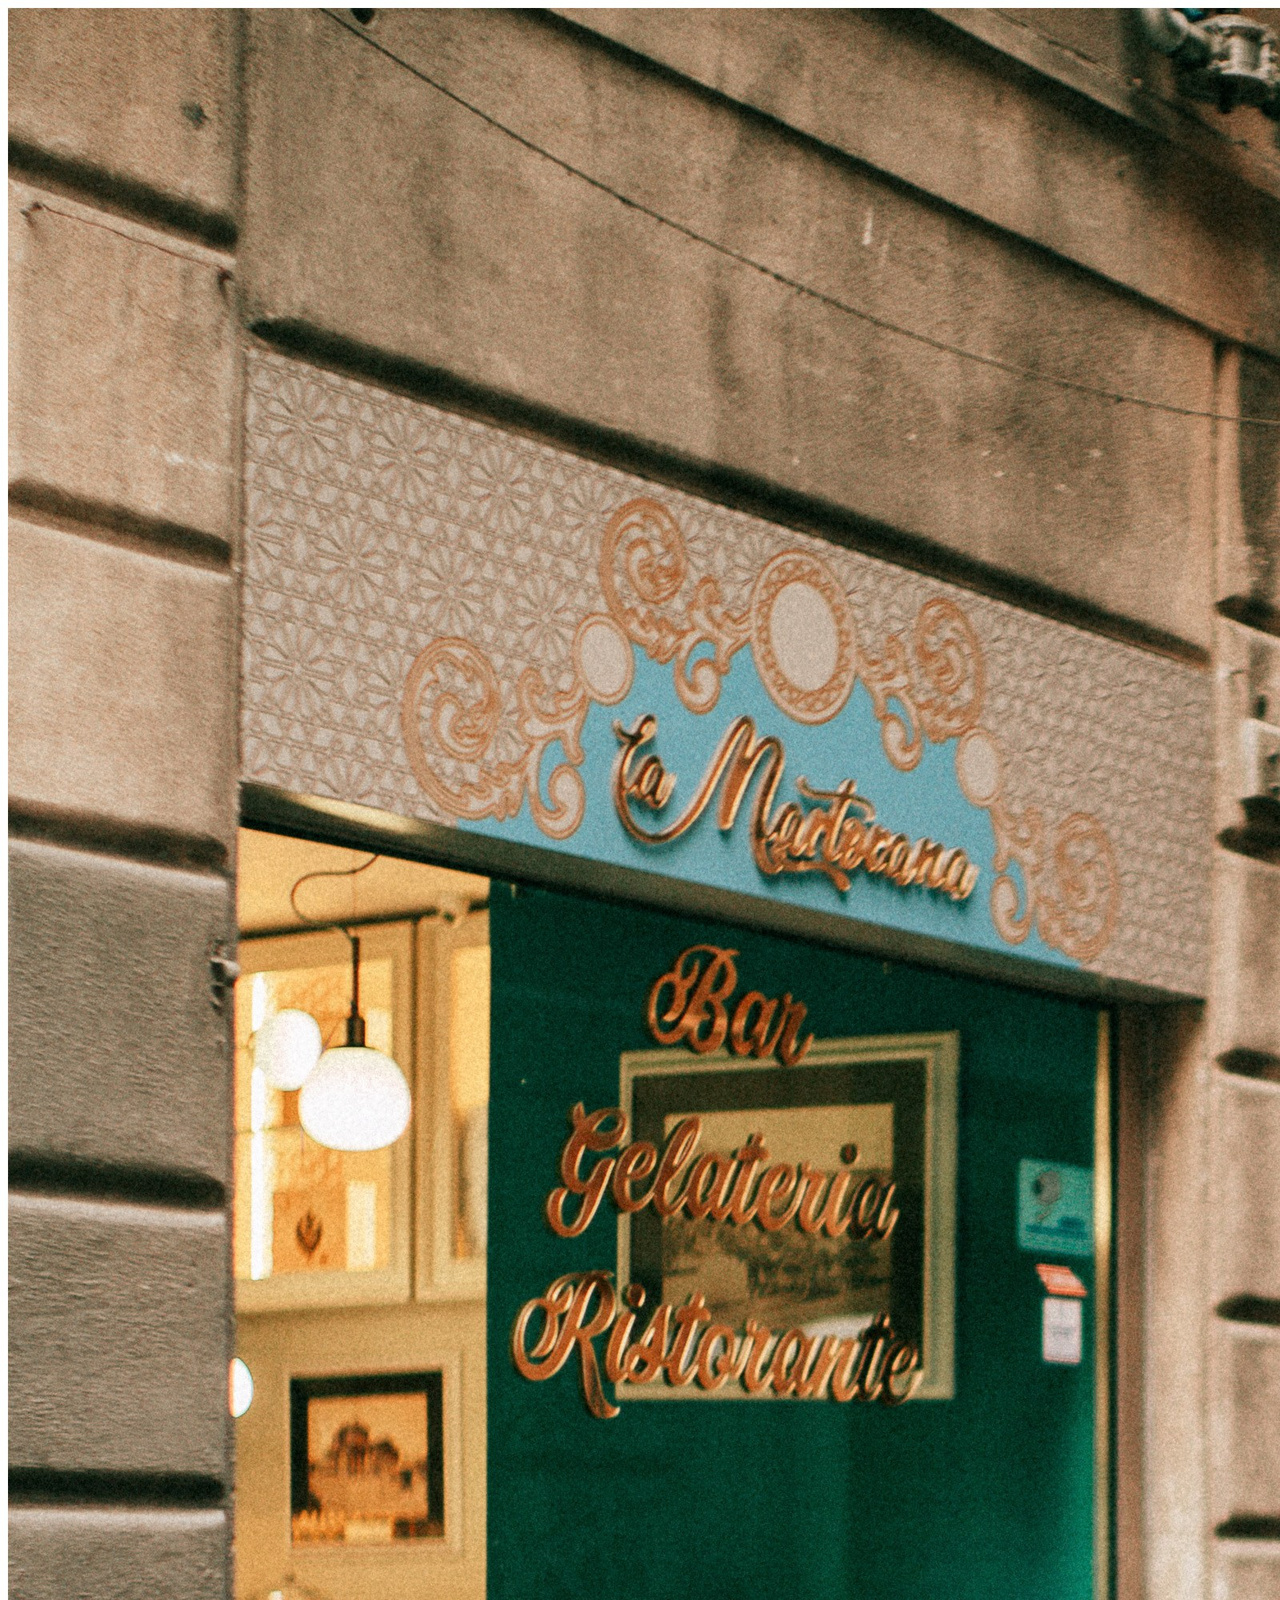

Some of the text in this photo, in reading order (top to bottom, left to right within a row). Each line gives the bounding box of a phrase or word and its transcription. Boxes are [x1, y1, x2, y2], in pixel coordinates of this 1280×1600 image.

[611, 713, 678, 844] La
[646, 943, 815, 1066] Bar
[544, 1102, 900, 1239] Gelateria
[510, 1270, 924, 1420] Ristorante
